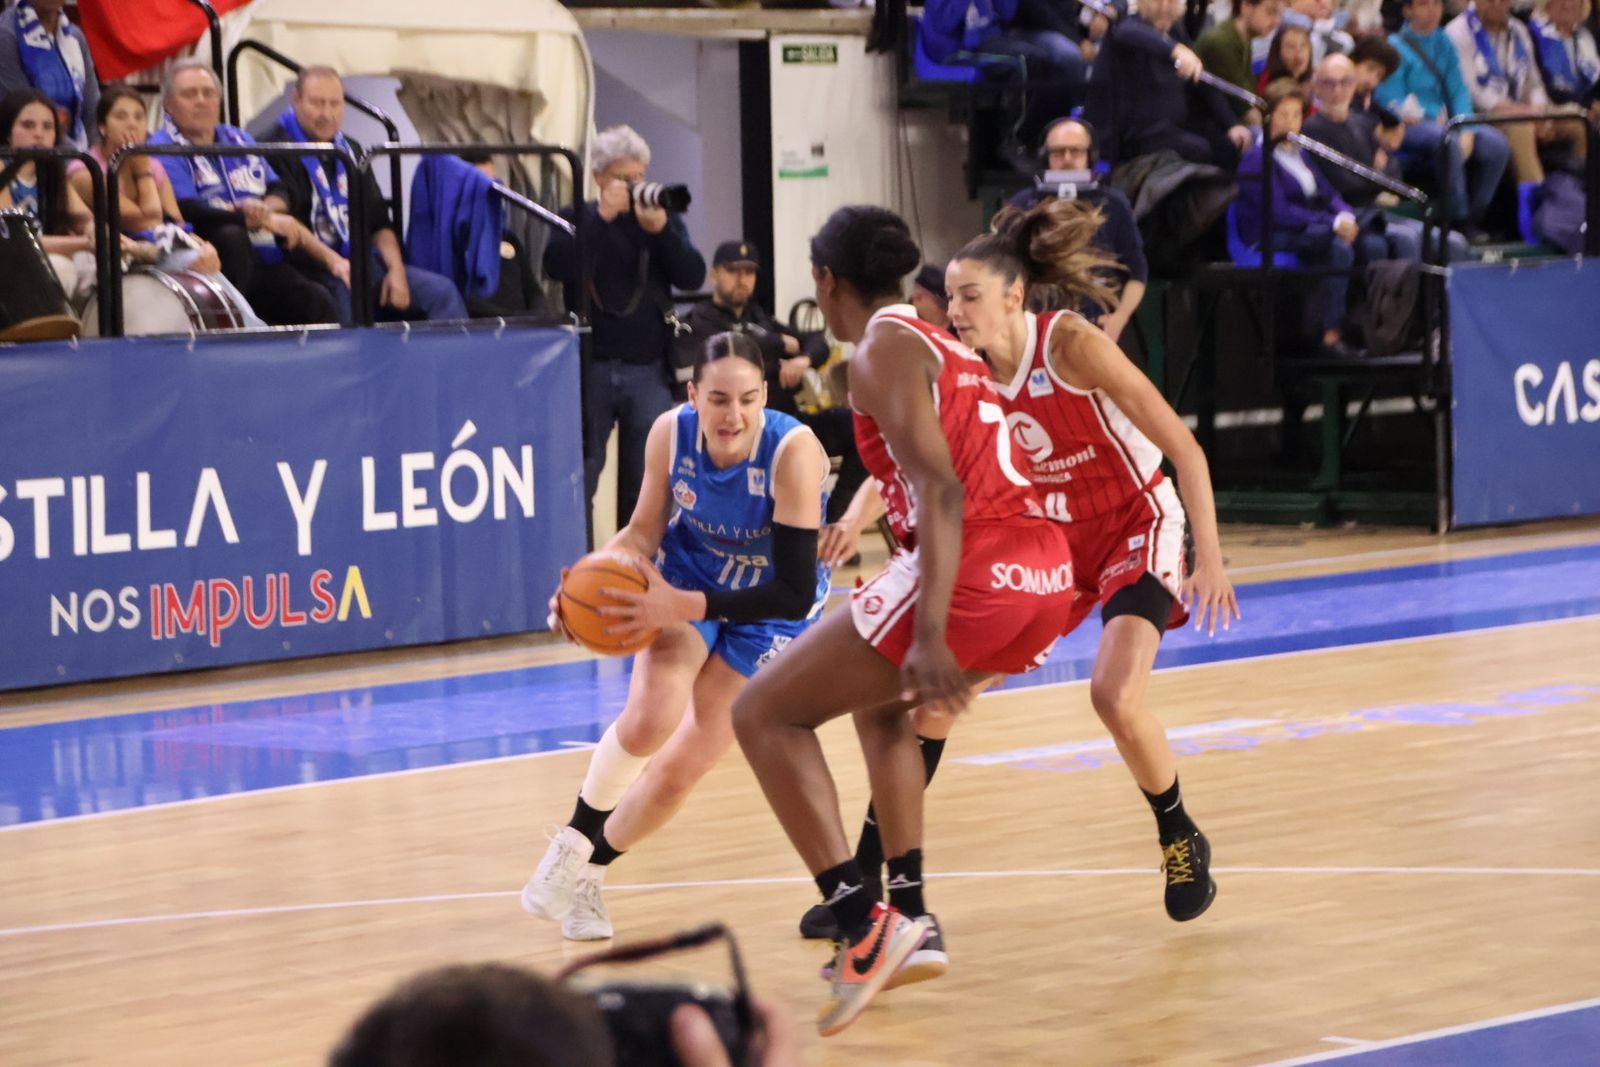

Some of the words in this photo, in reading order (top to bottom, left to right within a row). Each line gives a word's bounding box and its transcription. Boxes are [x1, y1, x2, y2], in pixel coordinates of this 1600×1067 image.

[277, 459, 327, 555] Y
[362, 419, 535, 532] LEÓN
[51, 587, 140, 636] NOS
[150, 565, 372, 647] IMPULSA
[991, 561, 1073, 595] SOMMO
